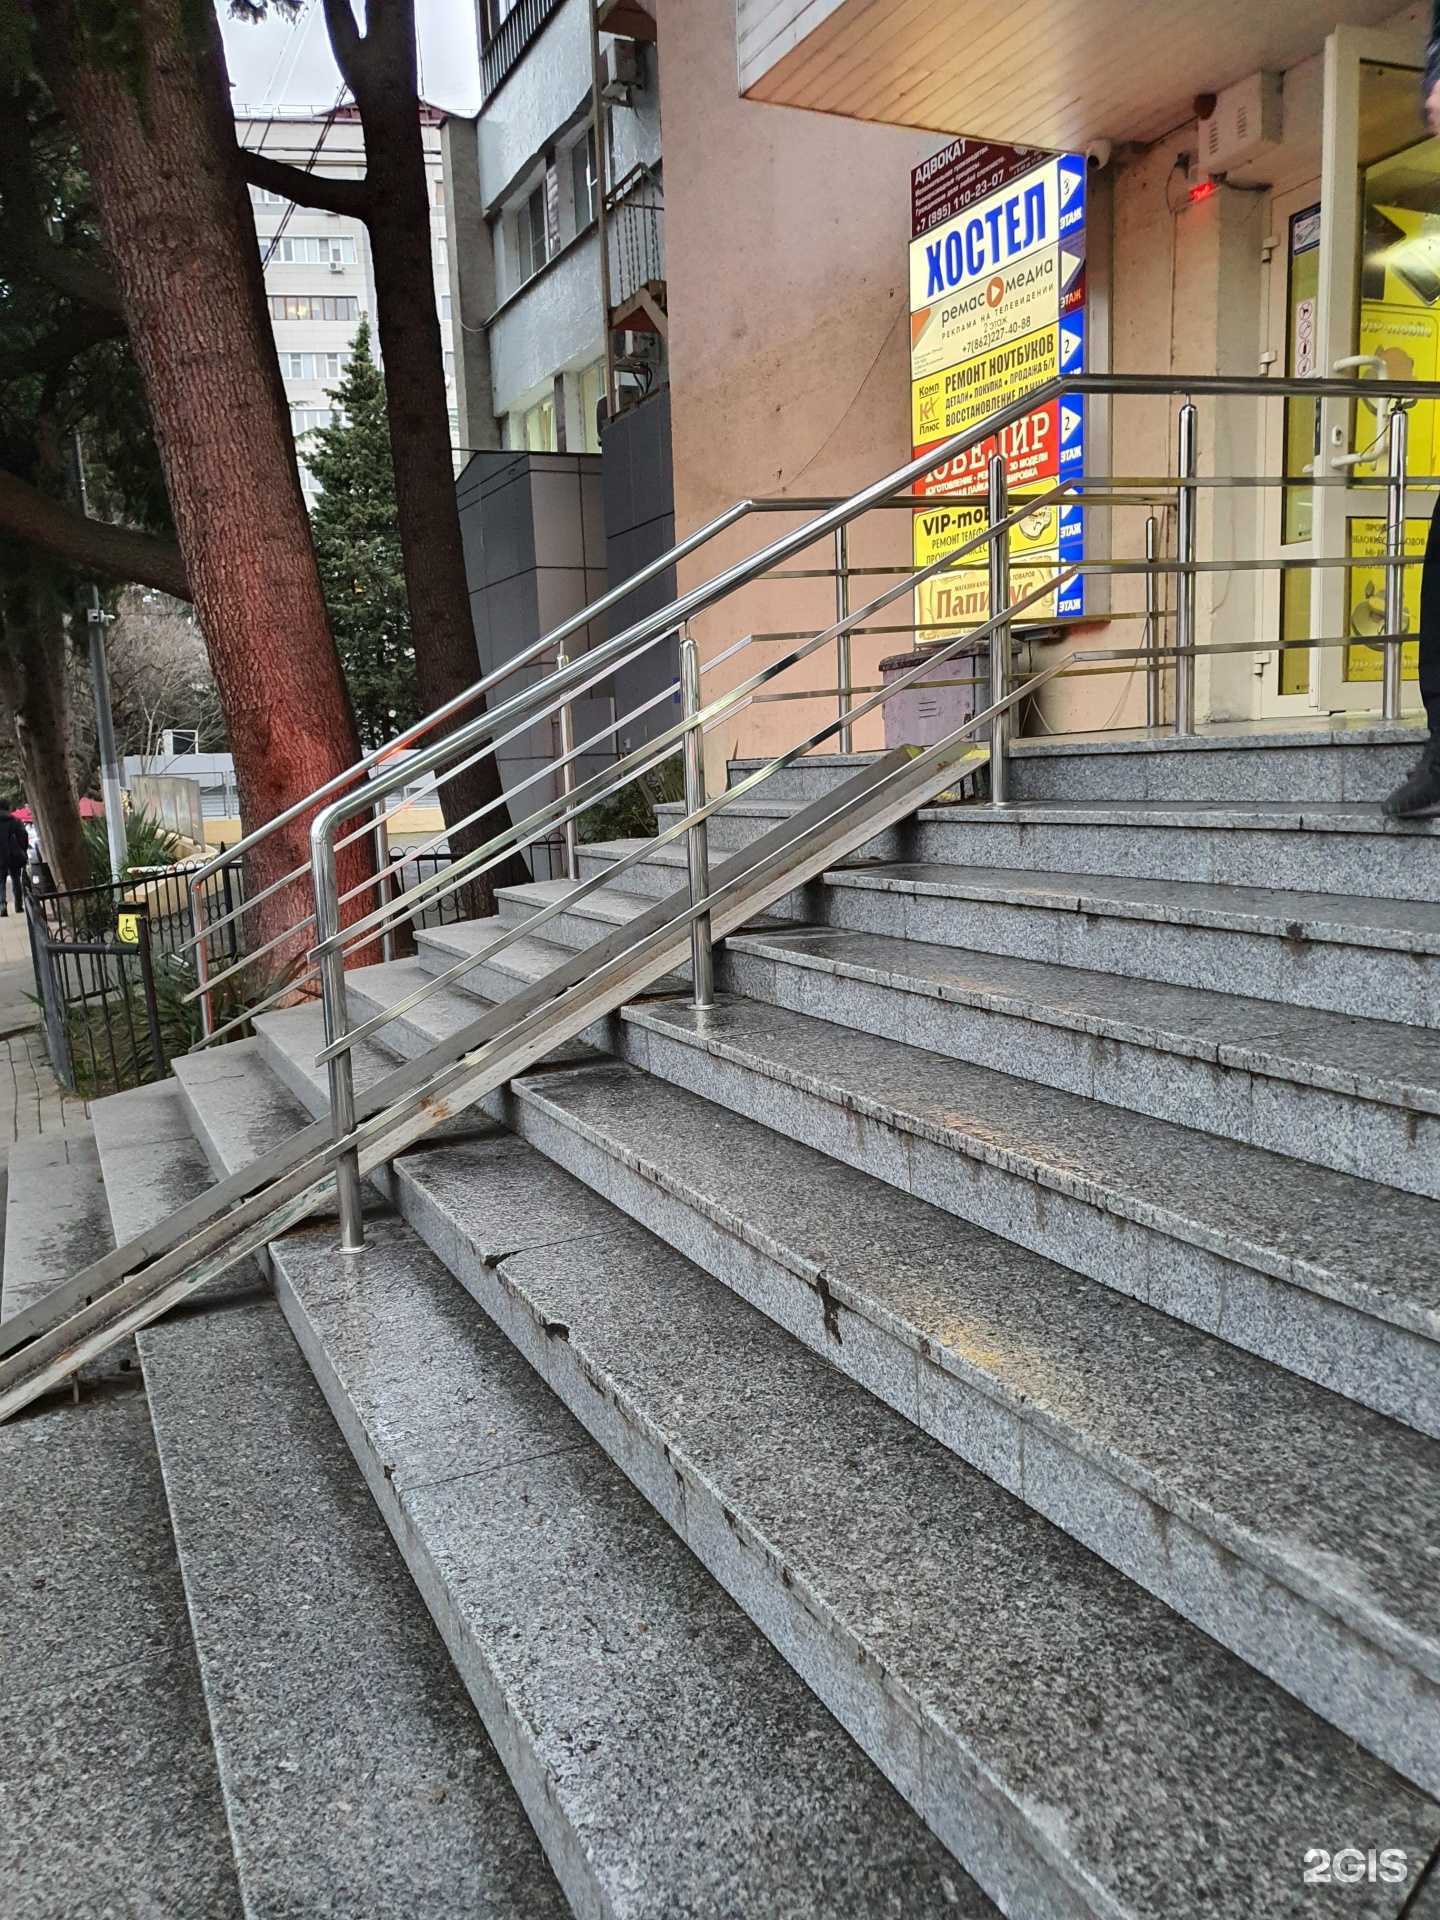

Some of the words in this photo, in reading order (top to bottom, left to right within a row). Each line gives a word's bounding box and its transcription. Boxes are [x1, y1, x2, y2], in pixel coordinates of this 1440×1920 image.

[914, 139, 967, 186] АДВОКАТ
[953, 169, 1004, 209] 110-23-07
[1063, 178, 1070, 196] 3
[1059, 206, 1082, 230] ЭТАЖ
[925, 181, 1046, 298] ХОСТЕЛ
[941, 292, 985, 328] ремас
[1004, 258, 1053, 293] медиа
[1060, 287, 1082, 308] ЭТАЖ
[941, 319, 977, 340] РЕКЛАМА
[980, 313, 991, 322] НА
[994, 283, 1054, 315] ТЕЛЕВИДЕНИИ
[1064, 340, 1070, 353] 2
[945, 361, 986, 394] РЕМОНТ
[989, 333, 1054, 377] НОУТБУКОВ
[919, 383, 940, 396] Комп
[974, 379, 1003, 397] ПОКУПКА
[1009, 363, 1042, 385] ПРОДАЖА
[945, 390, 1016, 427] ВОССТАНОВЛЕНИЕ
[919, 422, 940, 435] Плюс
[1064, 416, 1070, 431] 2
[1060, 446, 1082, 463] ЭТАЖ
[1060, 522, 1082, 538] ЭТАЖ
[931, 533, 960, 551] РЕМОНТ
[1058, 598, 1081, 613] ЭТАЖ
